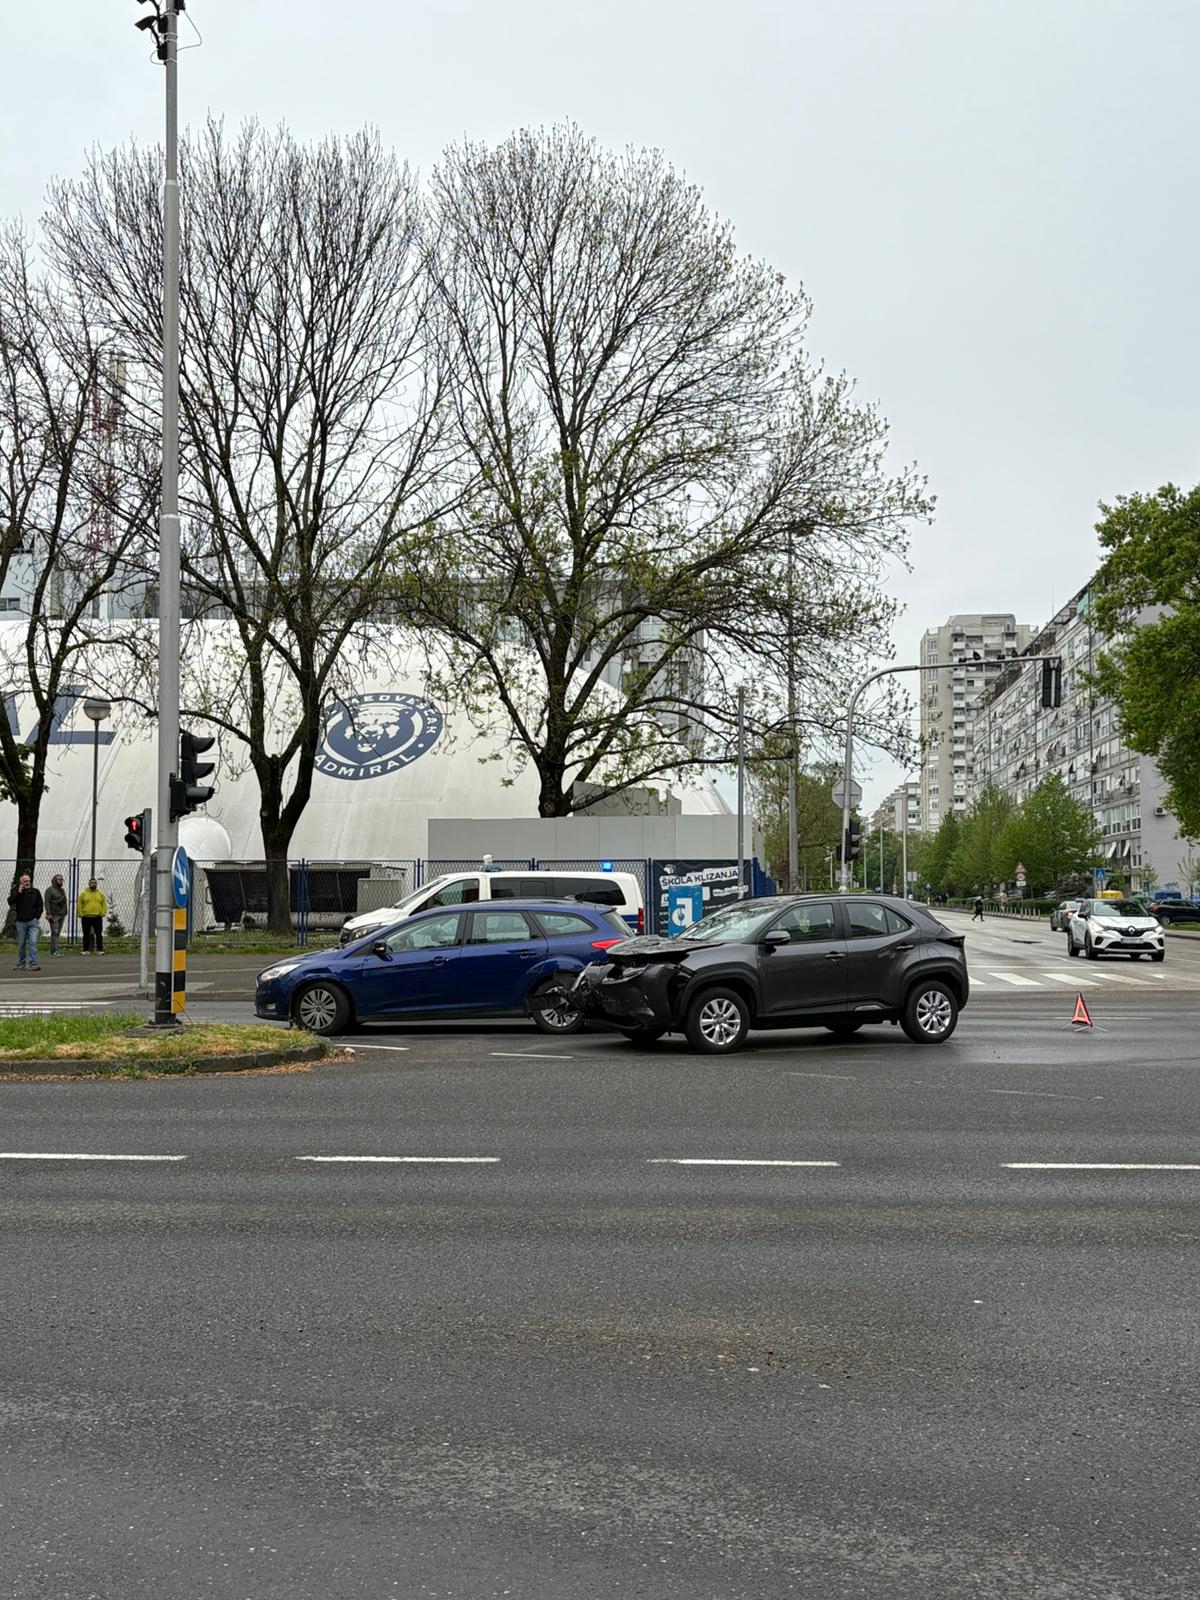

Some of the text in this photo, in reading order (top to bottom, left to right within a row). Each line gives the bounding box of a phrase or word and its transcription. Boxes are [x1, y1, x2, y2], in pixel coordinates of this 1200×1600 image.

[314, 753, 416, 777] ADMIRAL
[661, 870, 739, 887] ŠKOLA KLIZANJA
